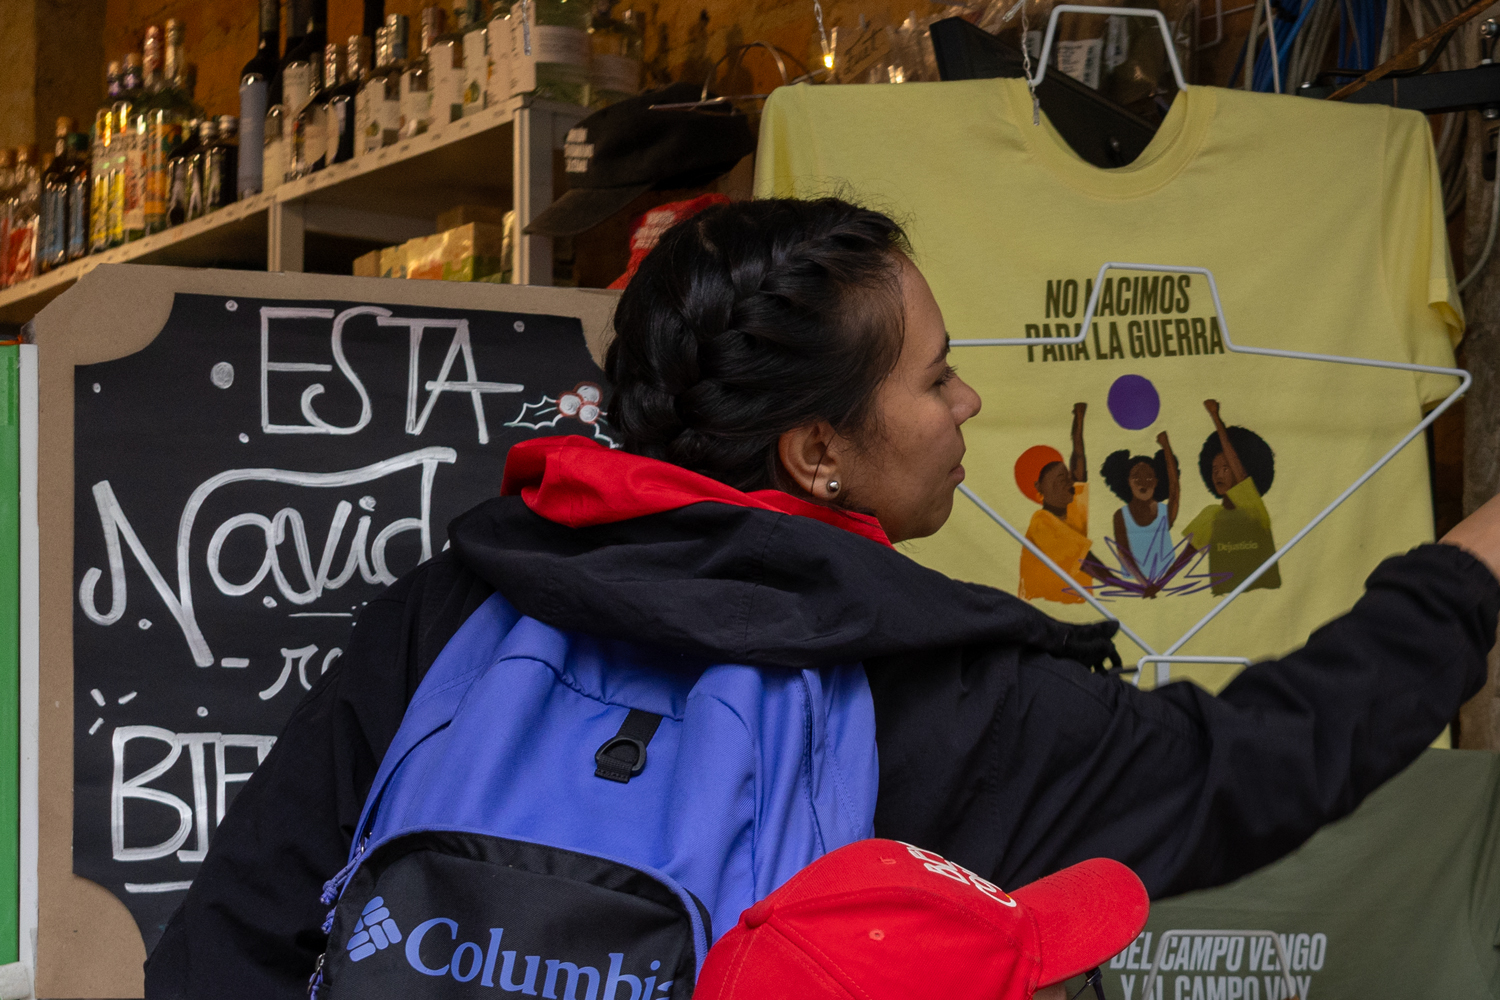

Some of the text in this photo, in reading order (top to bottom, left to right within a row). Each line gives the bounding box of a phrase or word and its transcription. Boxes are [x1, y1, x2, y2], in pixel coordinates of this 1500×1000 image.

[1045, 275, 1191, 318] NO NACIMOS
[1025, 316, 1225, 362] PARA LA GUERRA
[260, 306, 525, 443] ESTA
[79, 446, 458, 667] Navid
[1109, 931, 1327, 972] DEL CAMPO VENGO
